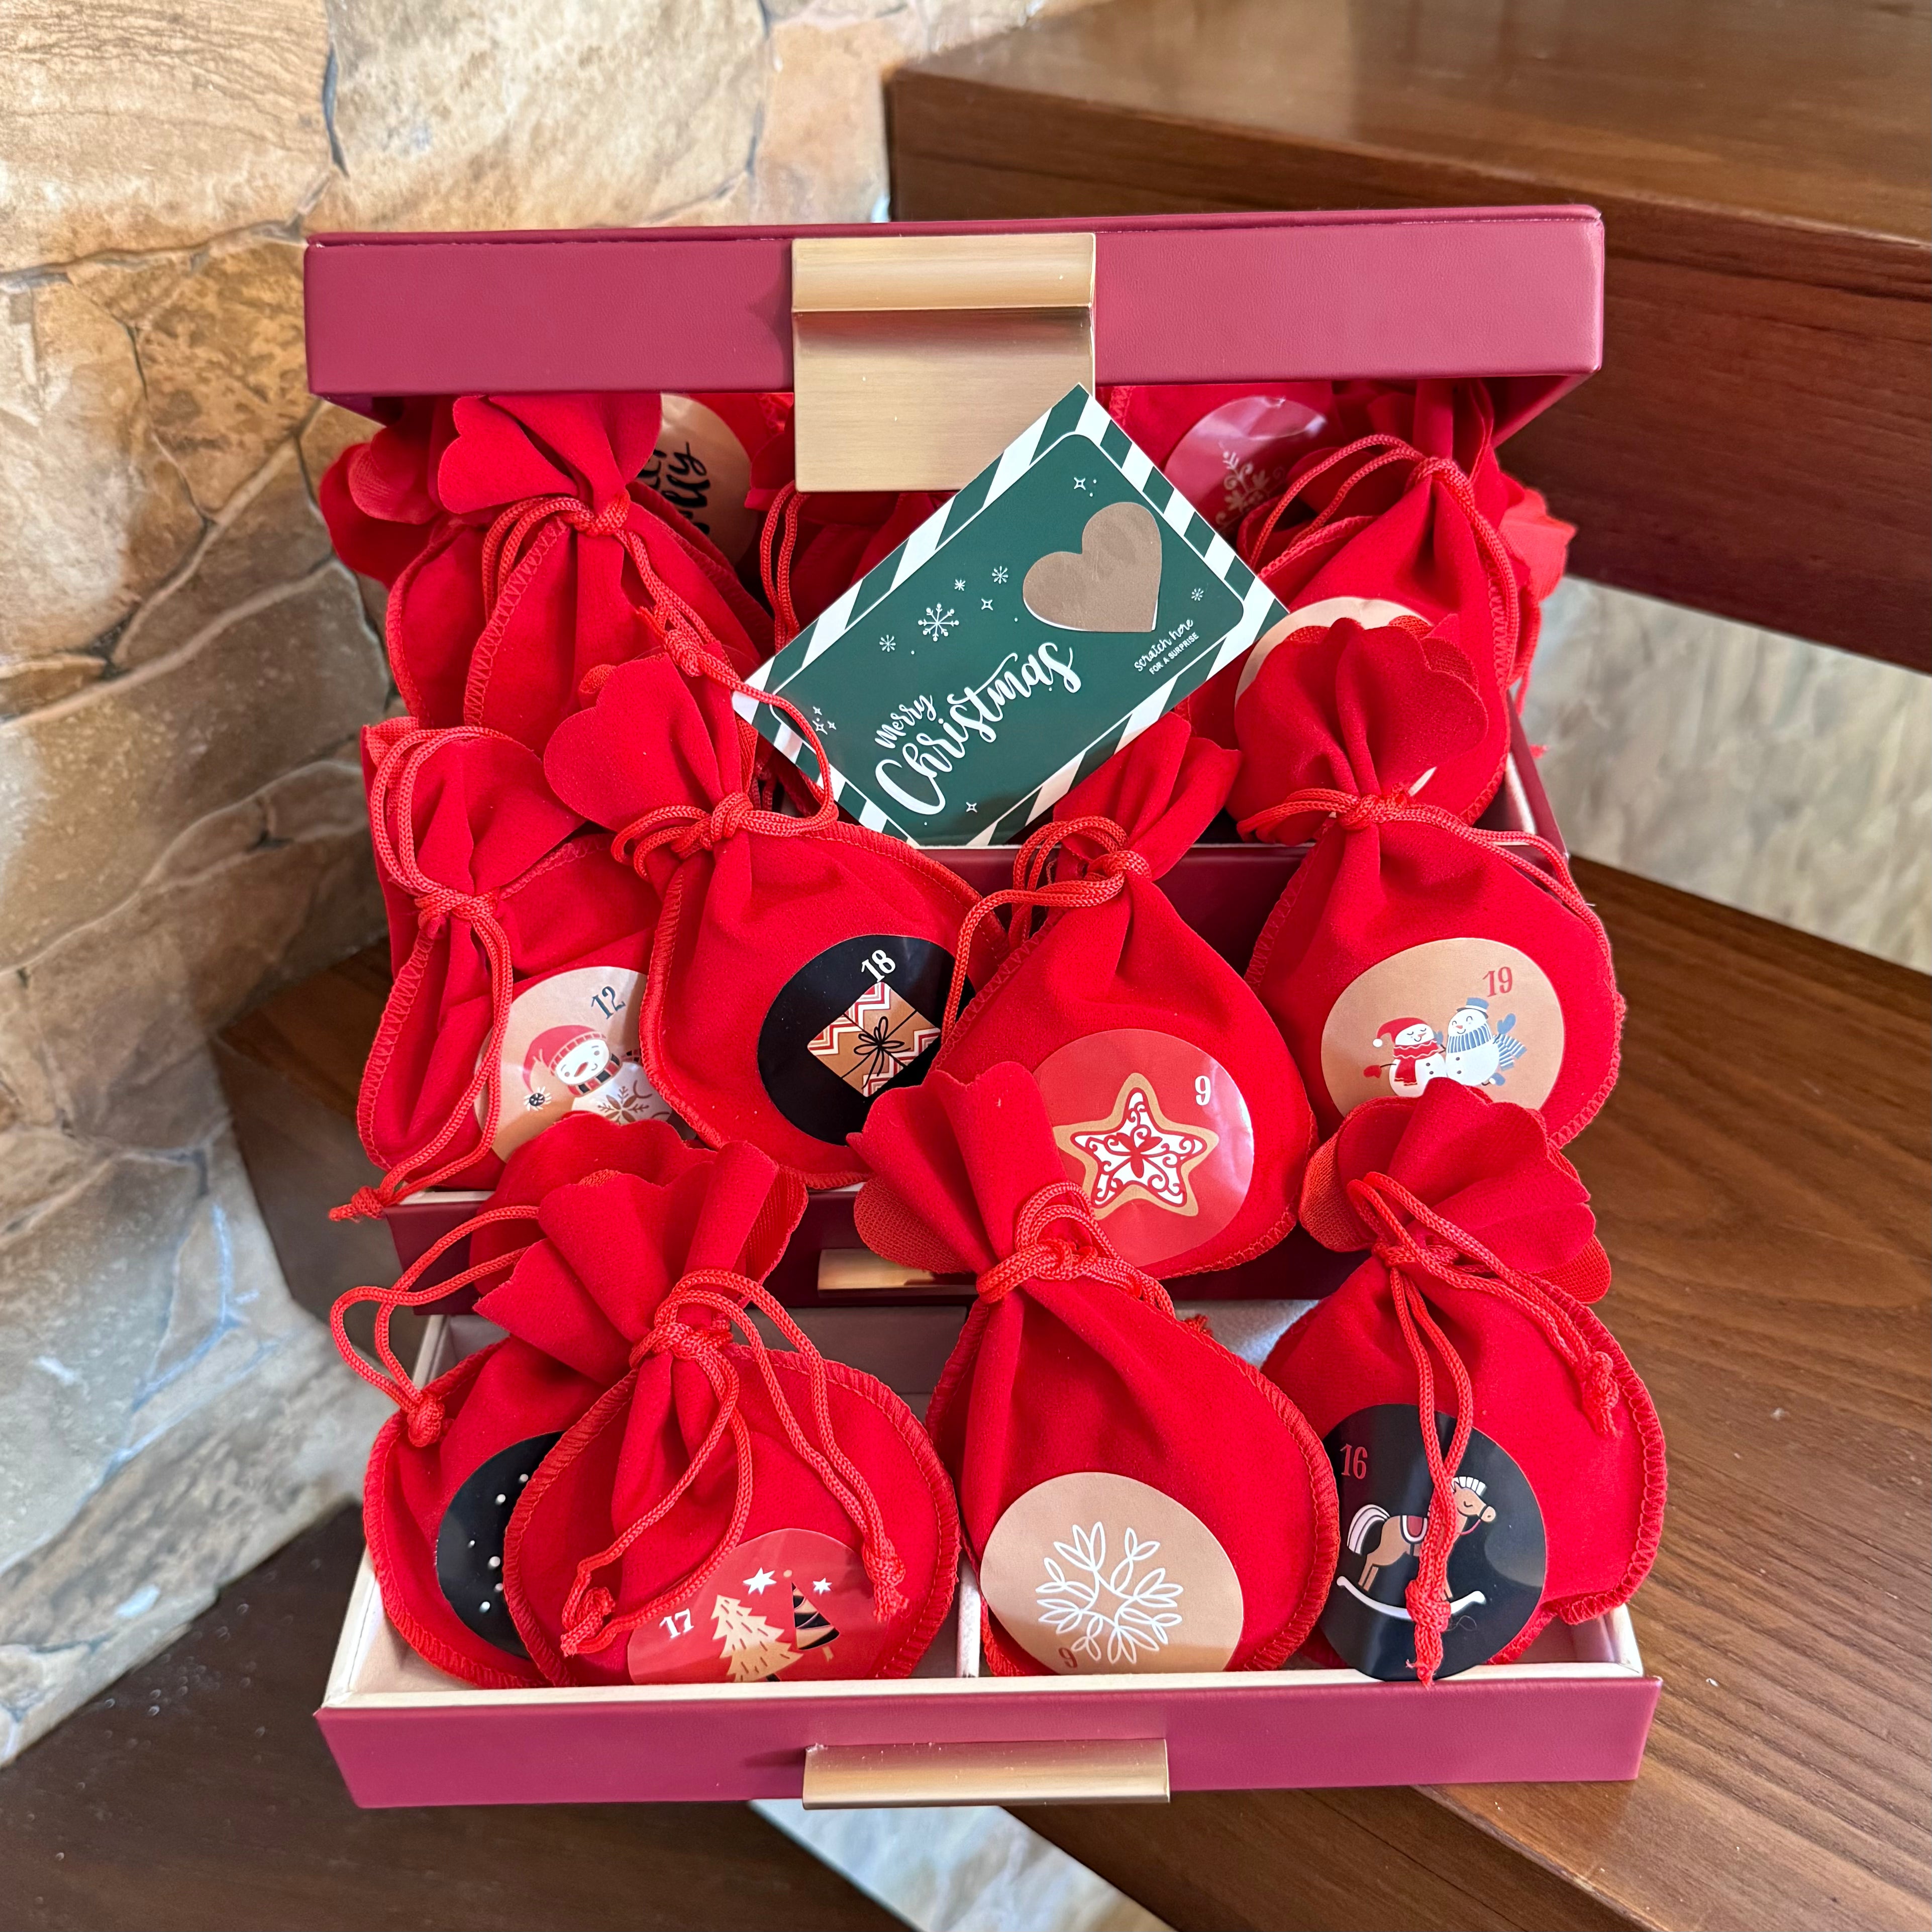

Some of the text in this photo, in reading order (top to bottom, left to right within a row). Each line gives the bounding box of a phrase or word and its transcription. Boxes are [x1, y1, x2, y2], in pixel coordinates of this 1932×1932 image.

[1149, 661, 1164, 675] FOR
[1168, 632, 1199, 659] SURPRISE
[875, 642, 1082, 816] Christmas
[861, 949, 896, 983] 18
[1483, 966, 1513, 997] 19
[591, 986, 626, 1020] 12
[1194, 1075, 1211, 1105] 9
[1340, 1443, 1368, 1480] 16
[659, 1608, 694, 1639] 17
